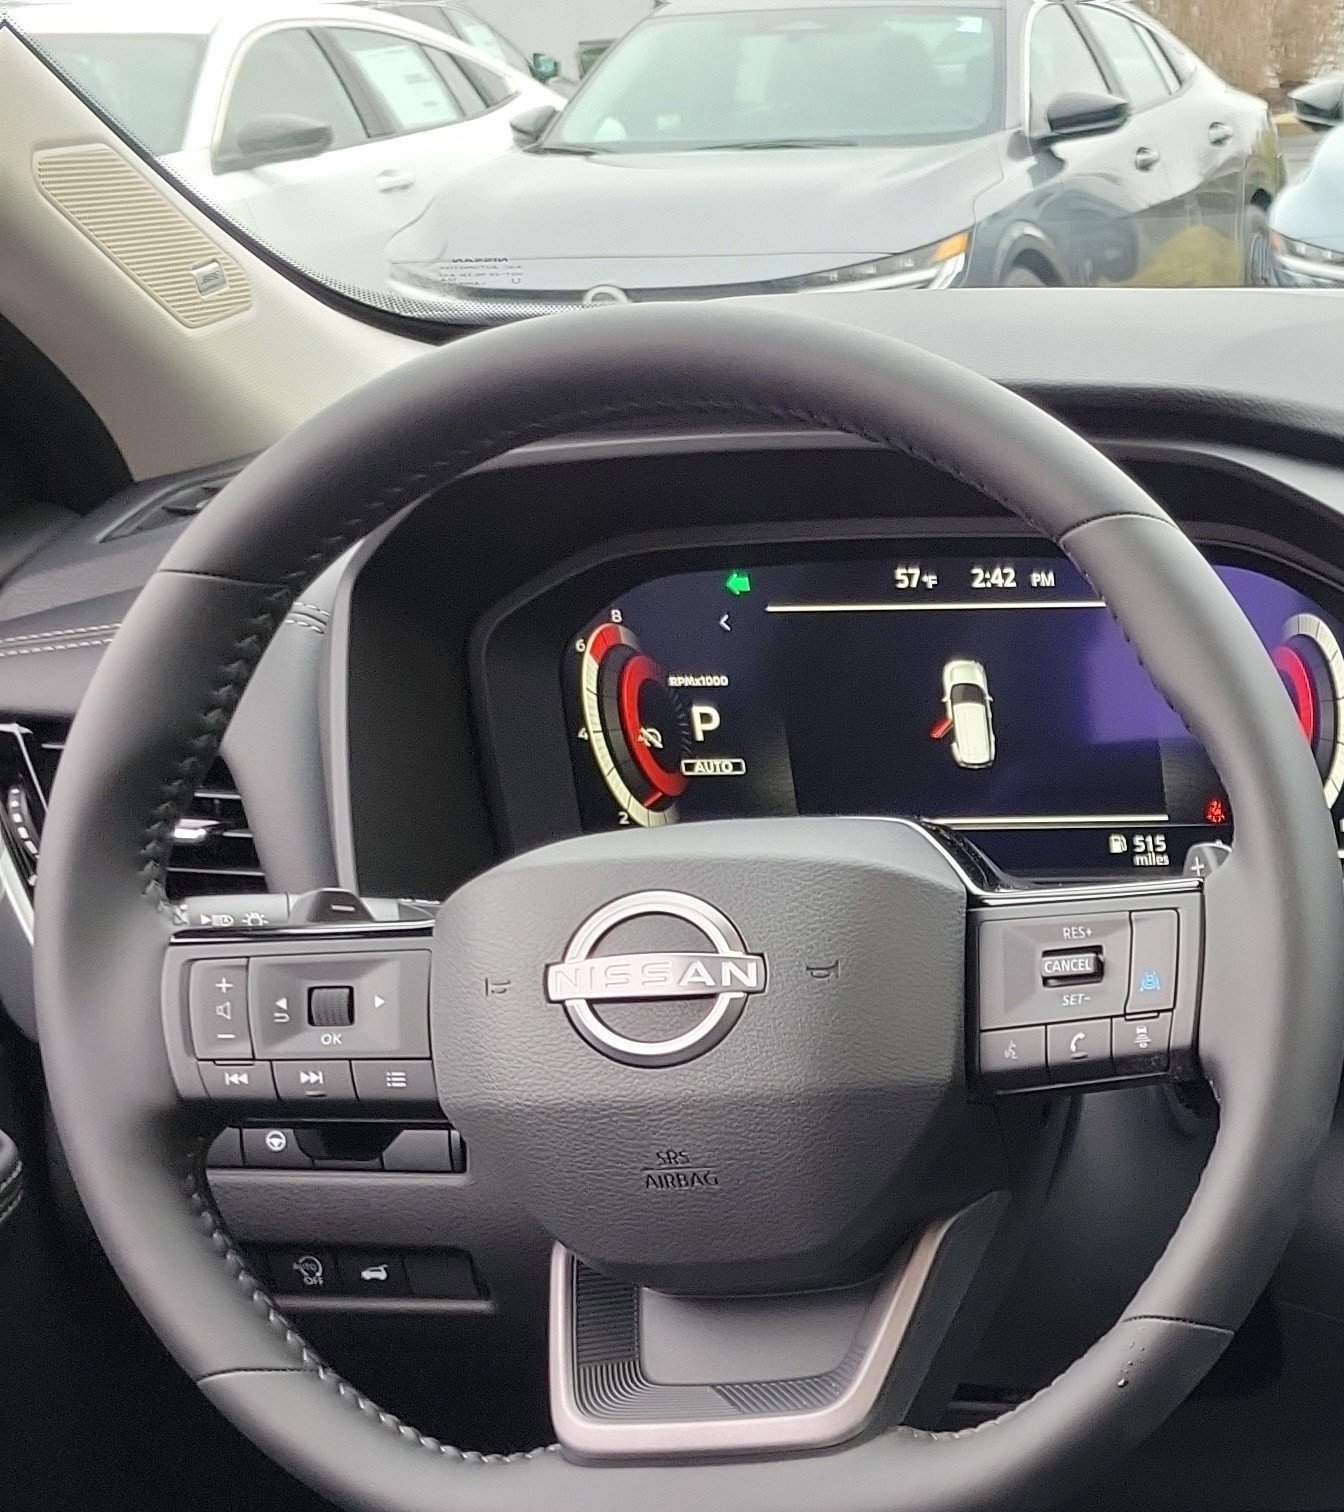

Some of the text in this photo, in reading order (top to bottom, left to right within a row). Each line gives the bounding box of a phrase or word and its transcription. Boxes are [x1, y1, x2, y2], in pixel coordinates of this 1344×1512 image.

[971, 568, 1055, 588] 2:42 PM
[576, 639, 585, 652] 6
[691, 705, 720, 741] P
[578, 727, 588, 740] 4
[693, 761, 734, 774] AUTO
[618, 813, 630, 824] 2
[1133, 835, 1167, 853] 515
[1133, 853, 1170, 866] miles
[1044, 959, 1092, 973] CANCEL
[554, 960, 757, 995] NISSAN
[321, 1033, 342, 1044] OK
[656, 1151, 690, 1165] SRS
[645, 1171, 718, 1189] AIRBAG
